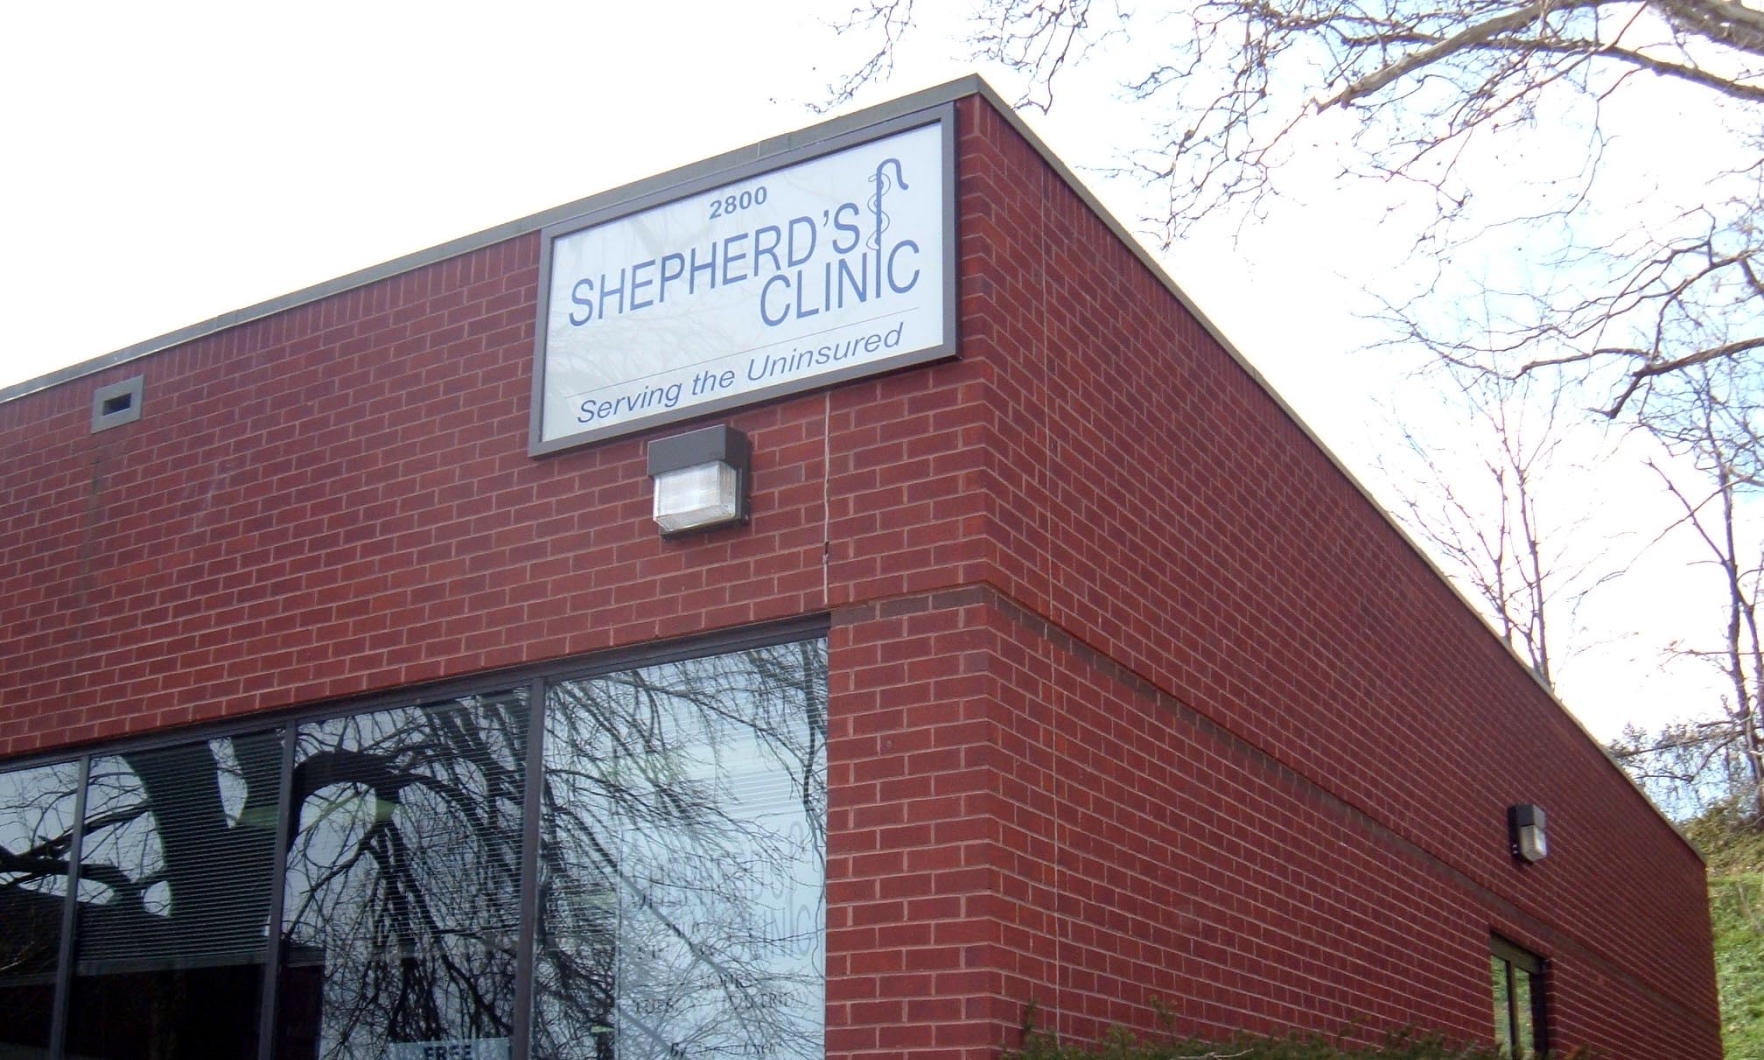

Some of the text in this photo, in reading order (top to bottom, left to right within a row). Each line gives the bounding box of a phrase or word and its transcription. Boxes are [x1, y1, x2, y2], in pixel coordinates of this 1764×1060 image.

[709, 186, 767, 220] 2800
[569, 202, 860, 327] SHEPHERD'S
[760, 239, 920, 326] CLINIC
[577, 321, 904, 423] Serving the Uninsured
[424, 1044, 472, 1060] FREE
